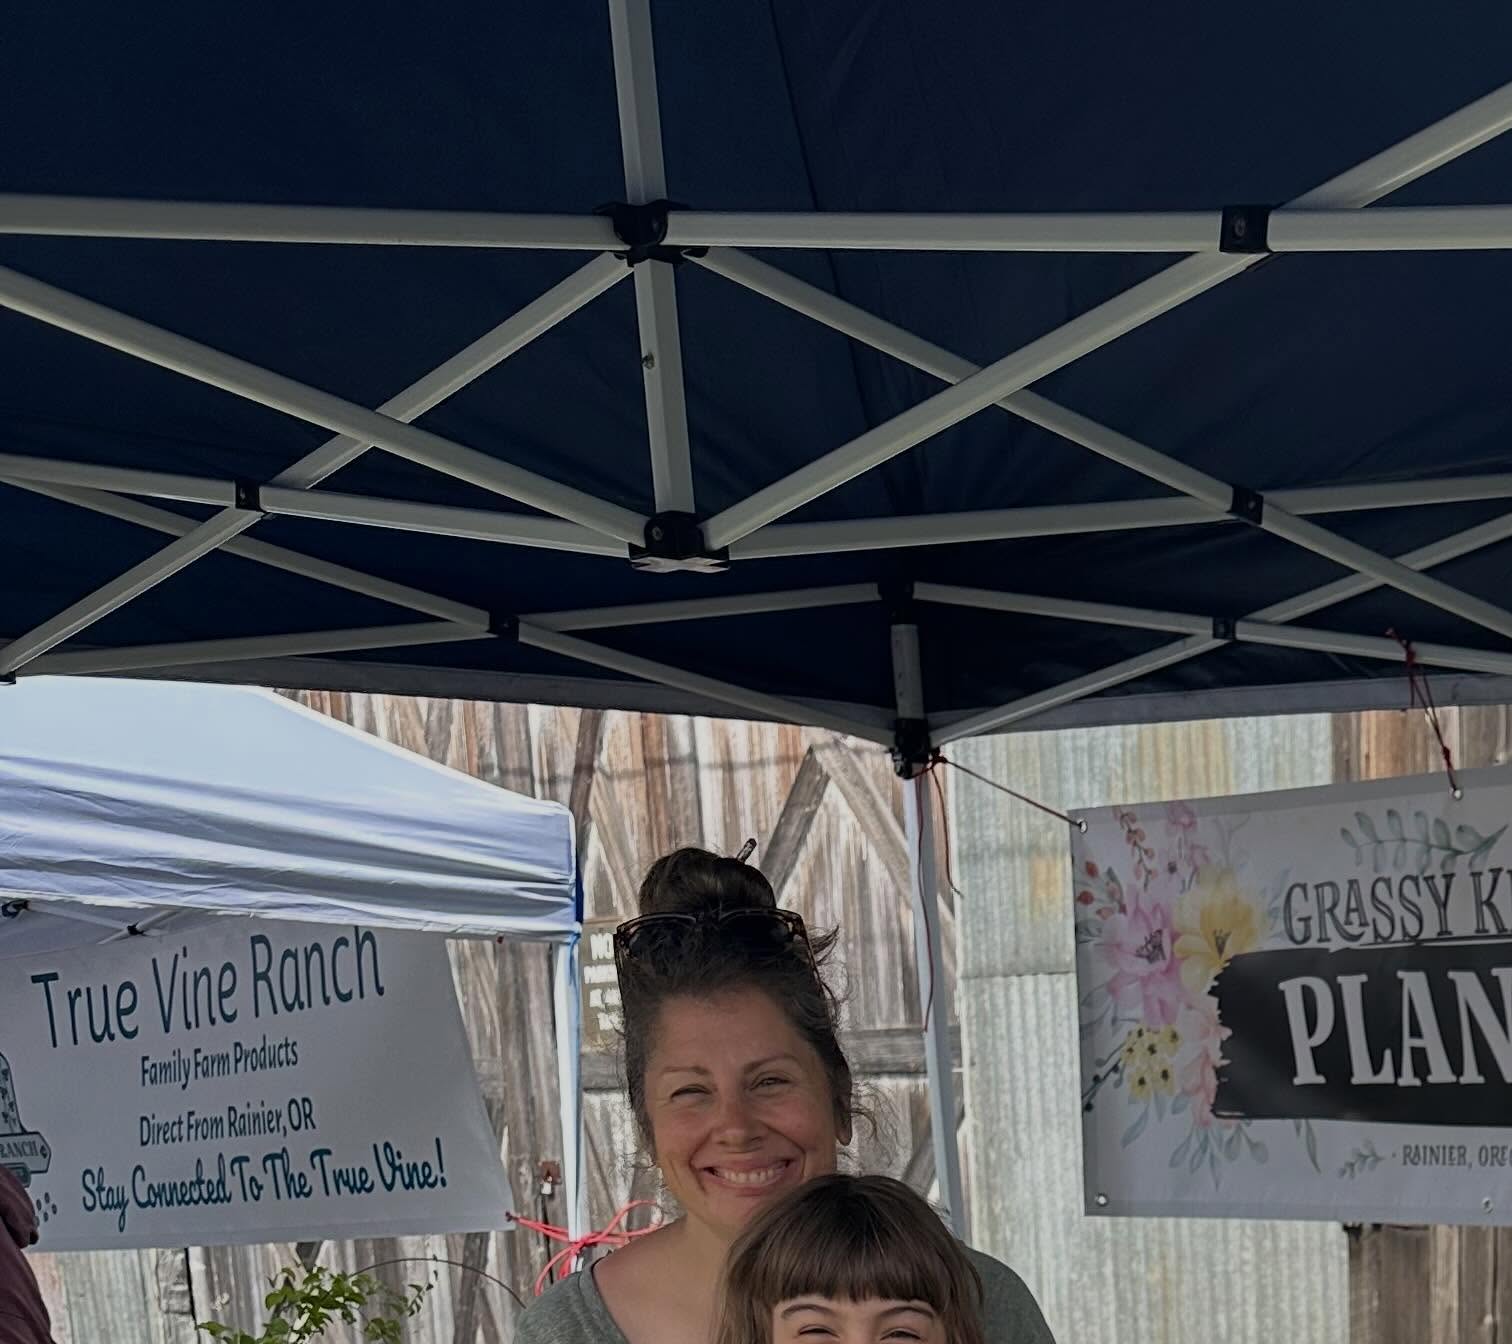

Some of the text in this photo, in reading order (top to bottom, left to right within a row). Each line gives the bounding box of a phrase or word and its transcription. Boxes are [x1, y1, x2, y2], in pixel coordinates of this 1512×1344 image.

[1282, 872, 1455, 949] GRASSY
[31, 925, 385, 1049] True Vine Ranch
[141, 1033, 299, 1090] Family Farm Products
[140, 1097, 316, 1146] Direct From Rainier, OR
[81, 1137, 447, 1232] Stay Connected To The True Vine!
[1402, 1144, 1472, 1170] RAINIER,
